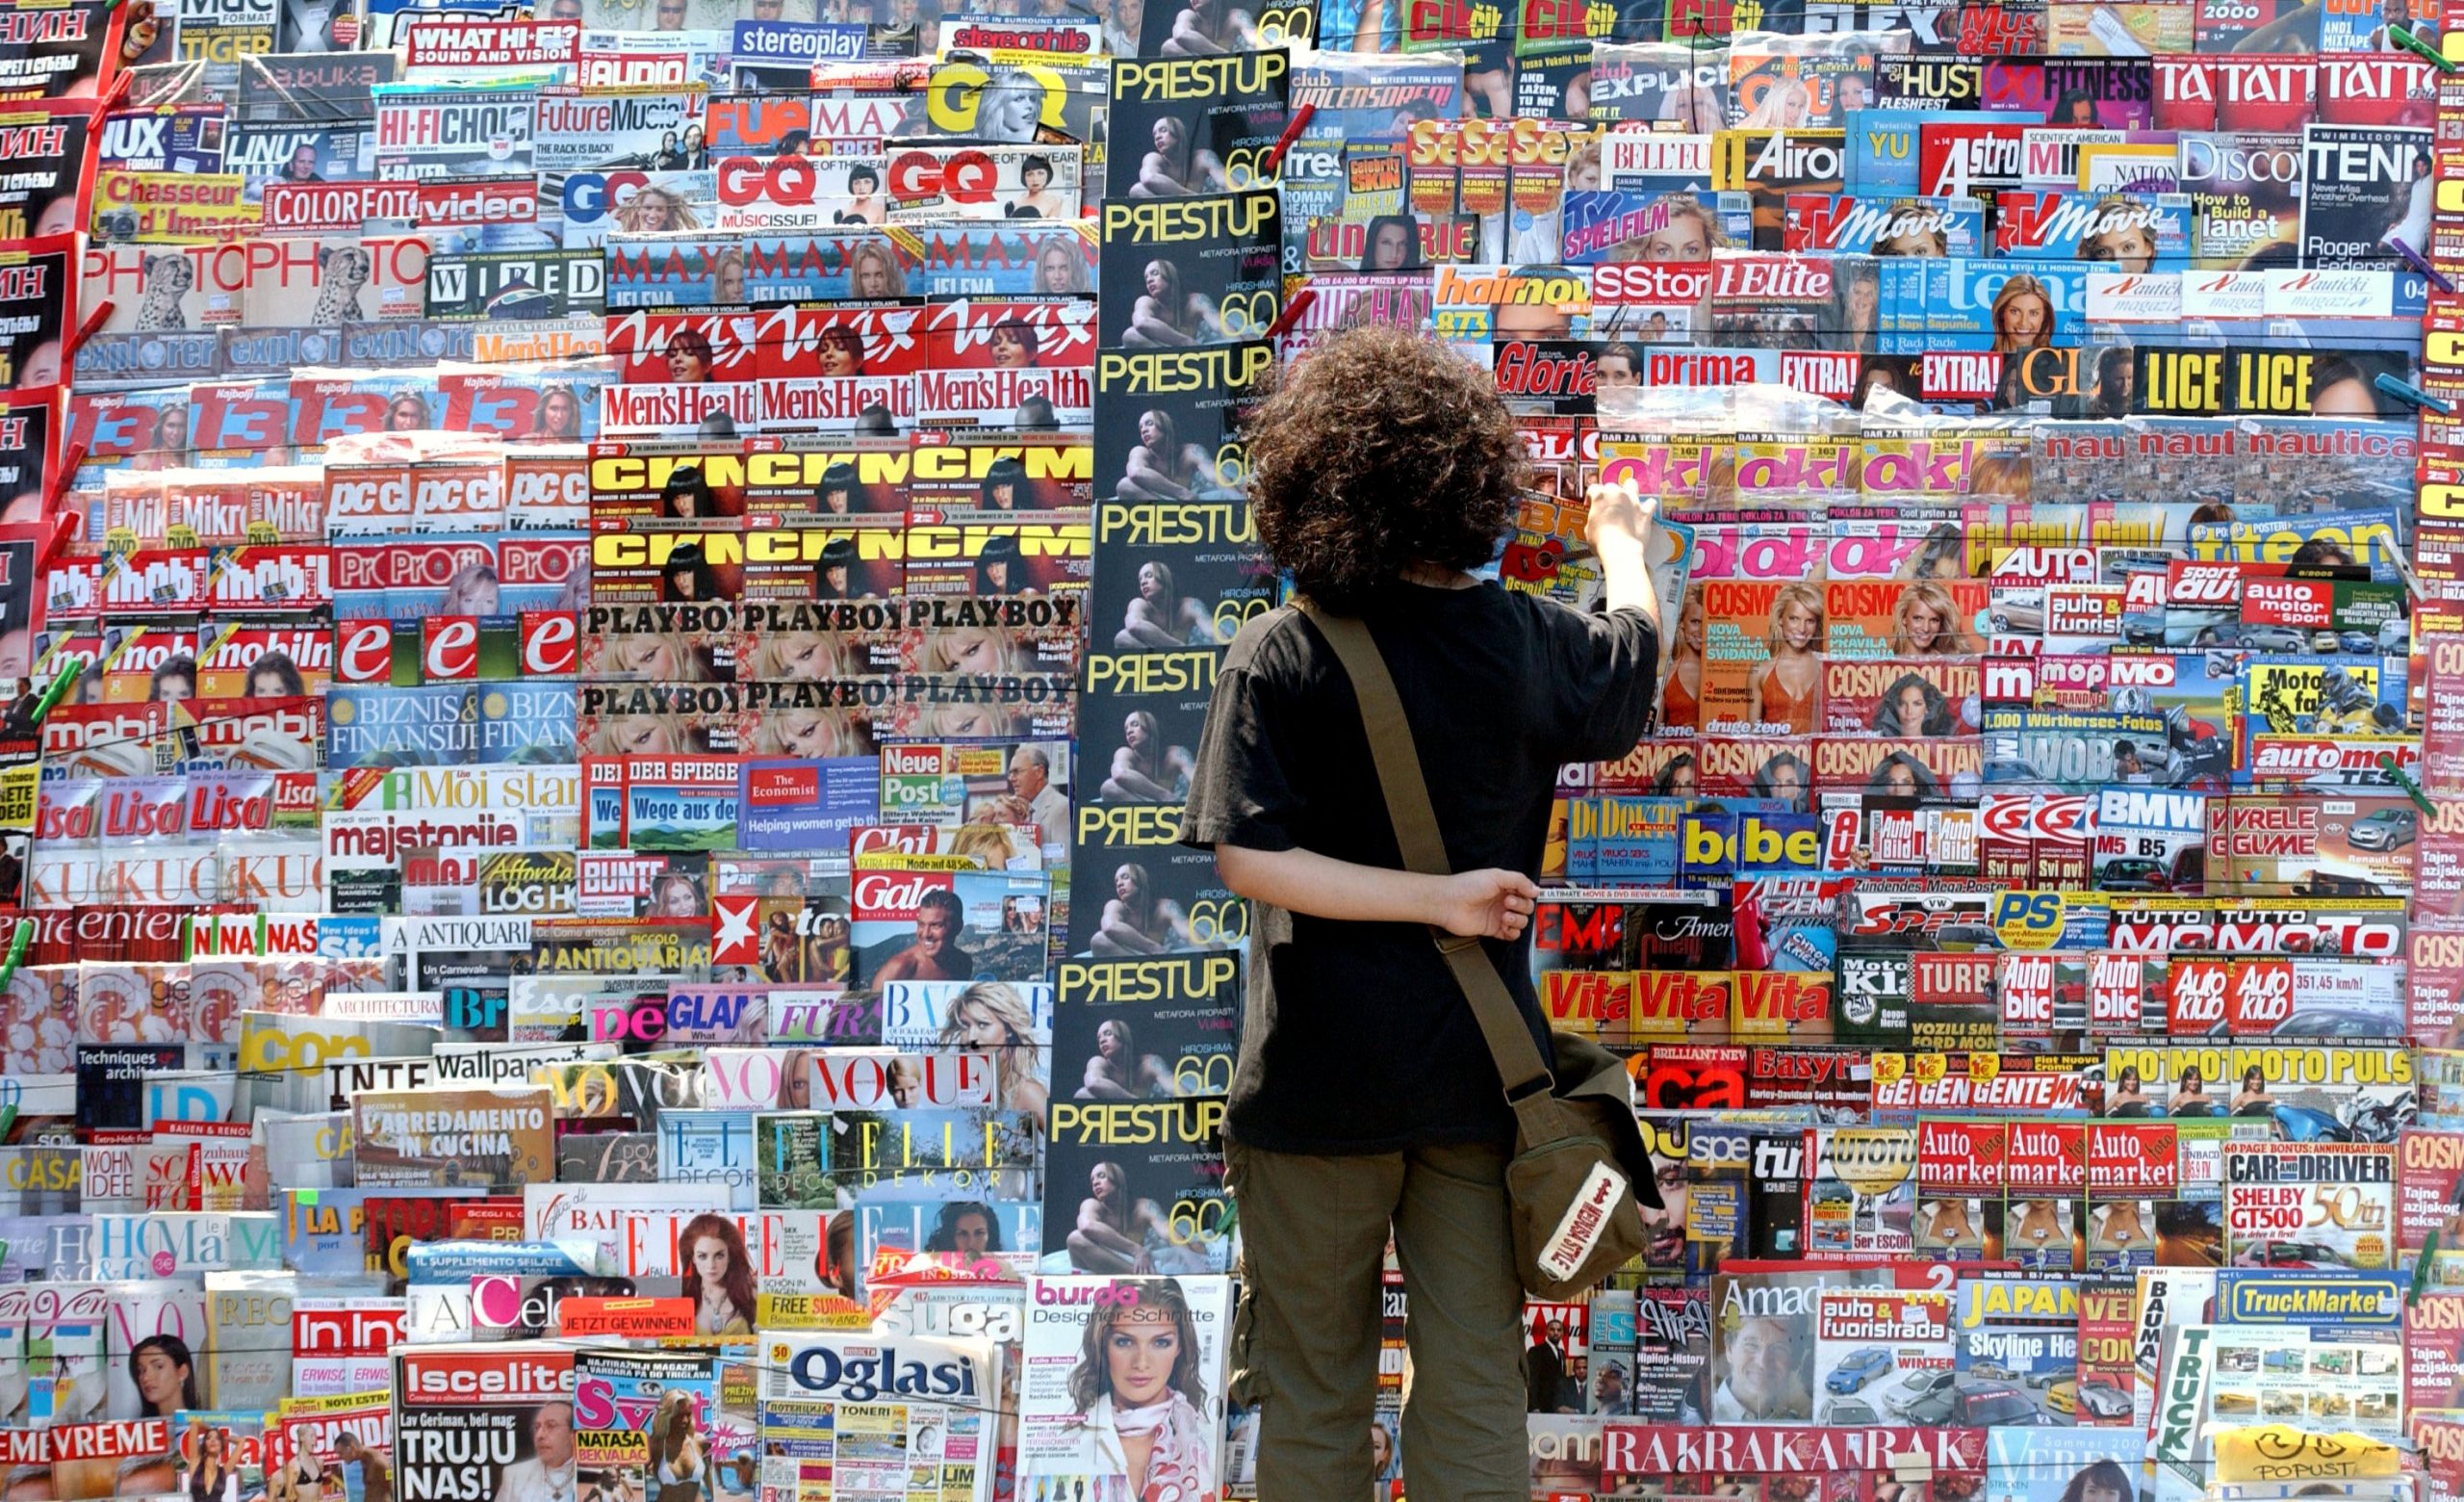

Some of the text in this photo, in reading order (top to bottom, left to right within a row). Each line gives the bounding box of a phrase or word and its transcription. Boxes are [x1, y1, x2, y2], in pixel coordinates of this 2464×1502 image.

[223, 14, 273, 24] FORMAT
[2203, 4, 2260, 20] 2000
[953, 25, 1091, 53] stereophile
[2323, 35, 2372, 50] MIXTAPE
[415, 48, 578, 64] SOUND AND VISION
[594, 61, 685, 85] AUDIO
[1520, 73, 1544, 83] AKO
[1533, 97, 1555, 107] ME
[1879, 97, 1950, 110] FLESHFEST
[2320, 131, 2402, 142] WIMBLEDON
[537, 142, 613, 153] THE RACK IS BACK!
[833, 139, 881, 155] FREE
[1868, 133, 1910, 159] YU
[126, 159, 166, 171] FORMAT
[718, 155, 818, 209] GQ
[887, 149, 999, 205] GQ
[107, 174, 240, 205] Chasseur
[2311, 183, 2361, 194] Never Miss
[2194, 192, 2249, 206] How to
[2311, 193, 2389, 203] Another Overhead
[422, 194, 536, 222] video
[2309, 236, 2371, 258] Roger
[476, 321, 603, 334] SPECIAL WEIGHT-LOSS
[1435, 310, 1492, 339] 873
[1496, 342, 1599, 396] Gloria
[1783, 355, 1858, 394] EXTRA!
[1923, 355, 2002, 392] EXTRA!
[2148, 353, 2222, 411] LICE
[2240, 352, 2313, 411] LICE
[2248, 428, 2417, 459] nautica
[2247, 584, 2312, 599] auto
[909, 599, 1076, 628] PLAYBOY
[2259, 599, 2324, 613] motor
[1707, 623, 1741, 635] NOVA
[1707, 635, 1763, 649] PRAVILA
[2288, 656, 2318, 664] TECHNIK
[2320, 656, 2338, 664] FÜR
[2112, 662, 2175, 686] MO
[904, 675, 1074, 704] PLAYBOY
[1706, 720, 1791, 736] druge žene
[1984, 712, 2021, 729] 1.000
[885, 749, 940, 775] Neue
[773, 774, 794, 786] The
[275, 780, 317, 805] Lisa
[752, 785, 815, 797] Economist
[885, 779, 939, 804] Post
[192, 783, 270, 831] Lisa
[635, 798, 710, 821] Wege aus
[2100, 790, 2204, 829] BMW
[2233, 806, 2320, 829] VRELE
[2097, 836, 2167, 858] M5 B5
[2233, 831, 2318, 856] GUME
[907, 857, 962, 868] Mode auf 48
[2422, 851, 2456, 865] Tajne
[1854, 878, 1924, 893] Zündendes
[486, 887, 545, 912] LOG
[1683, 891, 1706, 899] INSIDE
[1929, 899, 1948, 908] VW
[1997, 893, 2060, 929] PS
[2222, 910, 2308, 924] TUTTO
[267, 919, 318, 945] NAŠ
[630, 934, 679, 945] PICCOLO
[2012, 939, 2046, 948] Magazin
[424, 965, 489, 974] Un Carnevale
[2237, 964, 2290, 996] Auto
[1549, 972, 1630, 1020] Vita
[1639, 972, 1728, 1020] Vita
[1733, 972, 1829, 1020] Vita
[2004, 990, 2051, 1020] blic
[1154, 1007, 1234, 1020] METAFORA PROPASTI
[79, 1049, 157, 1066] Techniques
[1180, 1043, 1233, 1054] HIROSHIMA
[1174, 1053, 1234, 1097] 60
[1750, 1090, 1812, 1101] Harley-Davidson
[862, 1121, 1003, 1169] ELLE
[1920, 1125, 1970, 1157] Auto
[2223, 1144, 2238, 1154] 60
[2239, 1143, 2269, 1154] PAGE
[2271, 1143, 2313, 1154] BONUS:
[2314, 1143, 2372, 1156] ANNIVERSARY
[1920, 1162, 2005, 1185] market
[2229, 1154, 2390, 1182] CAR AND DRIVER
[863, 1170, 1001, 1189] DEKOR
[2233, 1187, 2307, 1205] SHELBY
[2230, 1208, 2302, 1230] GT500
[427, 1256, 515, 1268] SUPPLEMENTO
[1036, 1279, 1140, 1307] burda
[2244, 1290, 2387, 1314] TruckMarket
[772, 1297, 808, 1315] FREE
[1824, 1301, 1873, 1319] auto
[565, 1316, 693, 1332] JETZT GEWINNEN!
[1033, 1308, 1215, 1324] Designer-Schnitte
[1824, 1319, 1945, 1339] fuoristrada
[1968, 1333, 2043, 1360] Skyline
[652, 1362, 700, 1371] MAGAZIN
[1637, 1352, 1706, 1366] HipHop-History
[1897, 1357, 1955, 1370] WINTER
[791, 1345, 977, 1403] Oglasi
[840, 1407, 890, 1417] TONERI
[51, 1420, 166, 1459] VREME
[401, 1430, 517, 1464] TRUJU
[578, 1430, 644, 1448] NATAŠA
[578, 1447, 649, 1462] BEKVALAC
[943, 1468, 974, 1483] LIM
[2253, 1463, 2350, 1480] POPUST
[401, 1466, 492, 1502] NAS!
